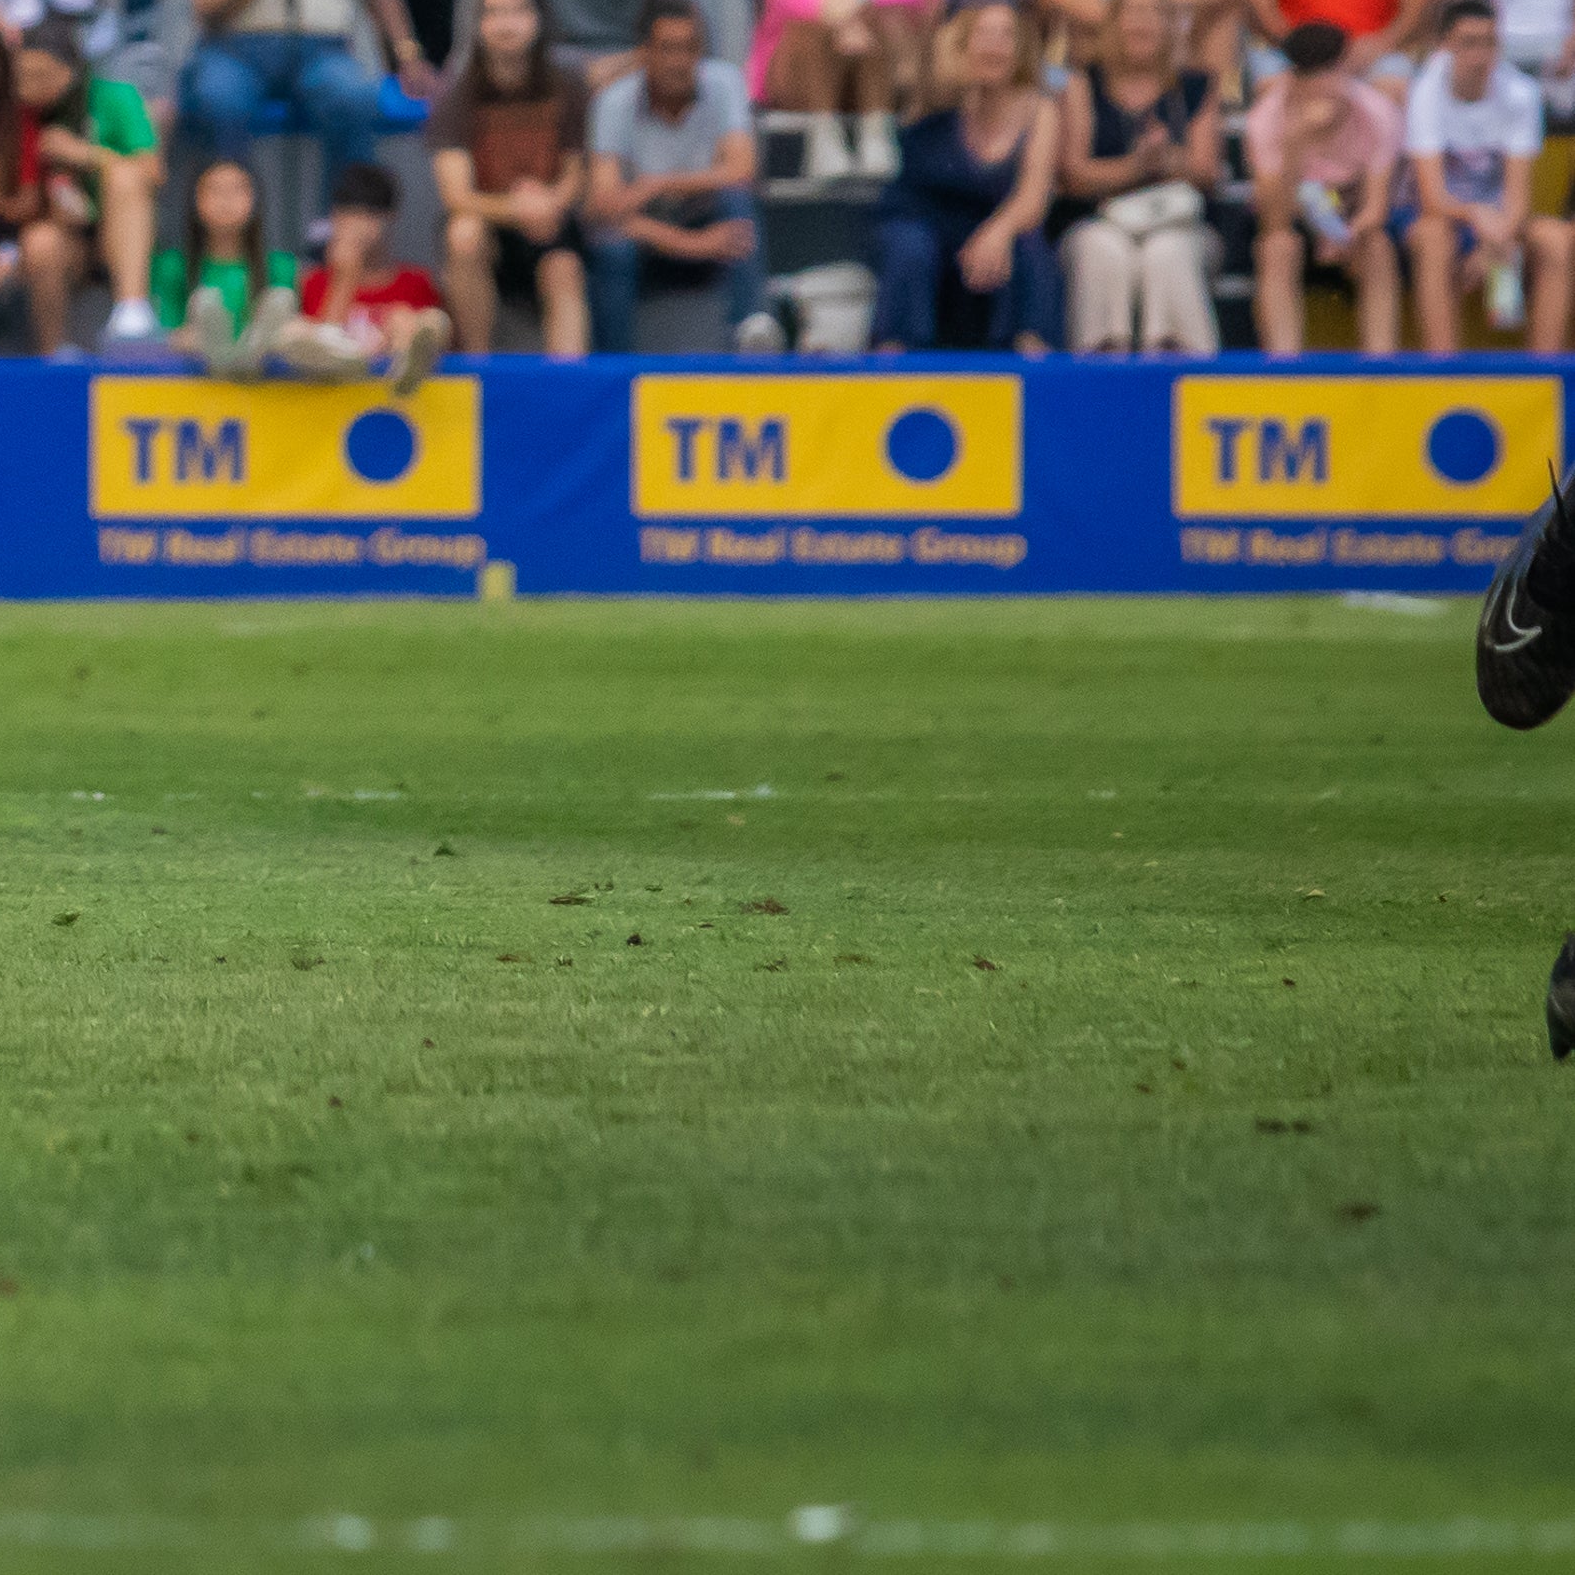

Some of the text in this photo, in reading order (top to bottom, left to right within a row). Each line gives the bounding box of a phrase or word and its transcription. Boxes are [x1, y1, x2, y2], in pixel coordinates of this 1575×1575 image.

[123, 419, 248, 484] TM
[666, 418, 789, 483] TM
[1206, 418, 1329, 483] TM
[164, 528, 248, 565] Real
[251, 528, 364, 566] Estate
[366, 528, 488, 569] Group
[704, 528, 786, 565] Real
[790, 528, 904, 566] Estate
[907, 528, 1028, 569] Group
[1244, 528, 1328, 565] Real
[1331, 528, 1448, 566] Estate
